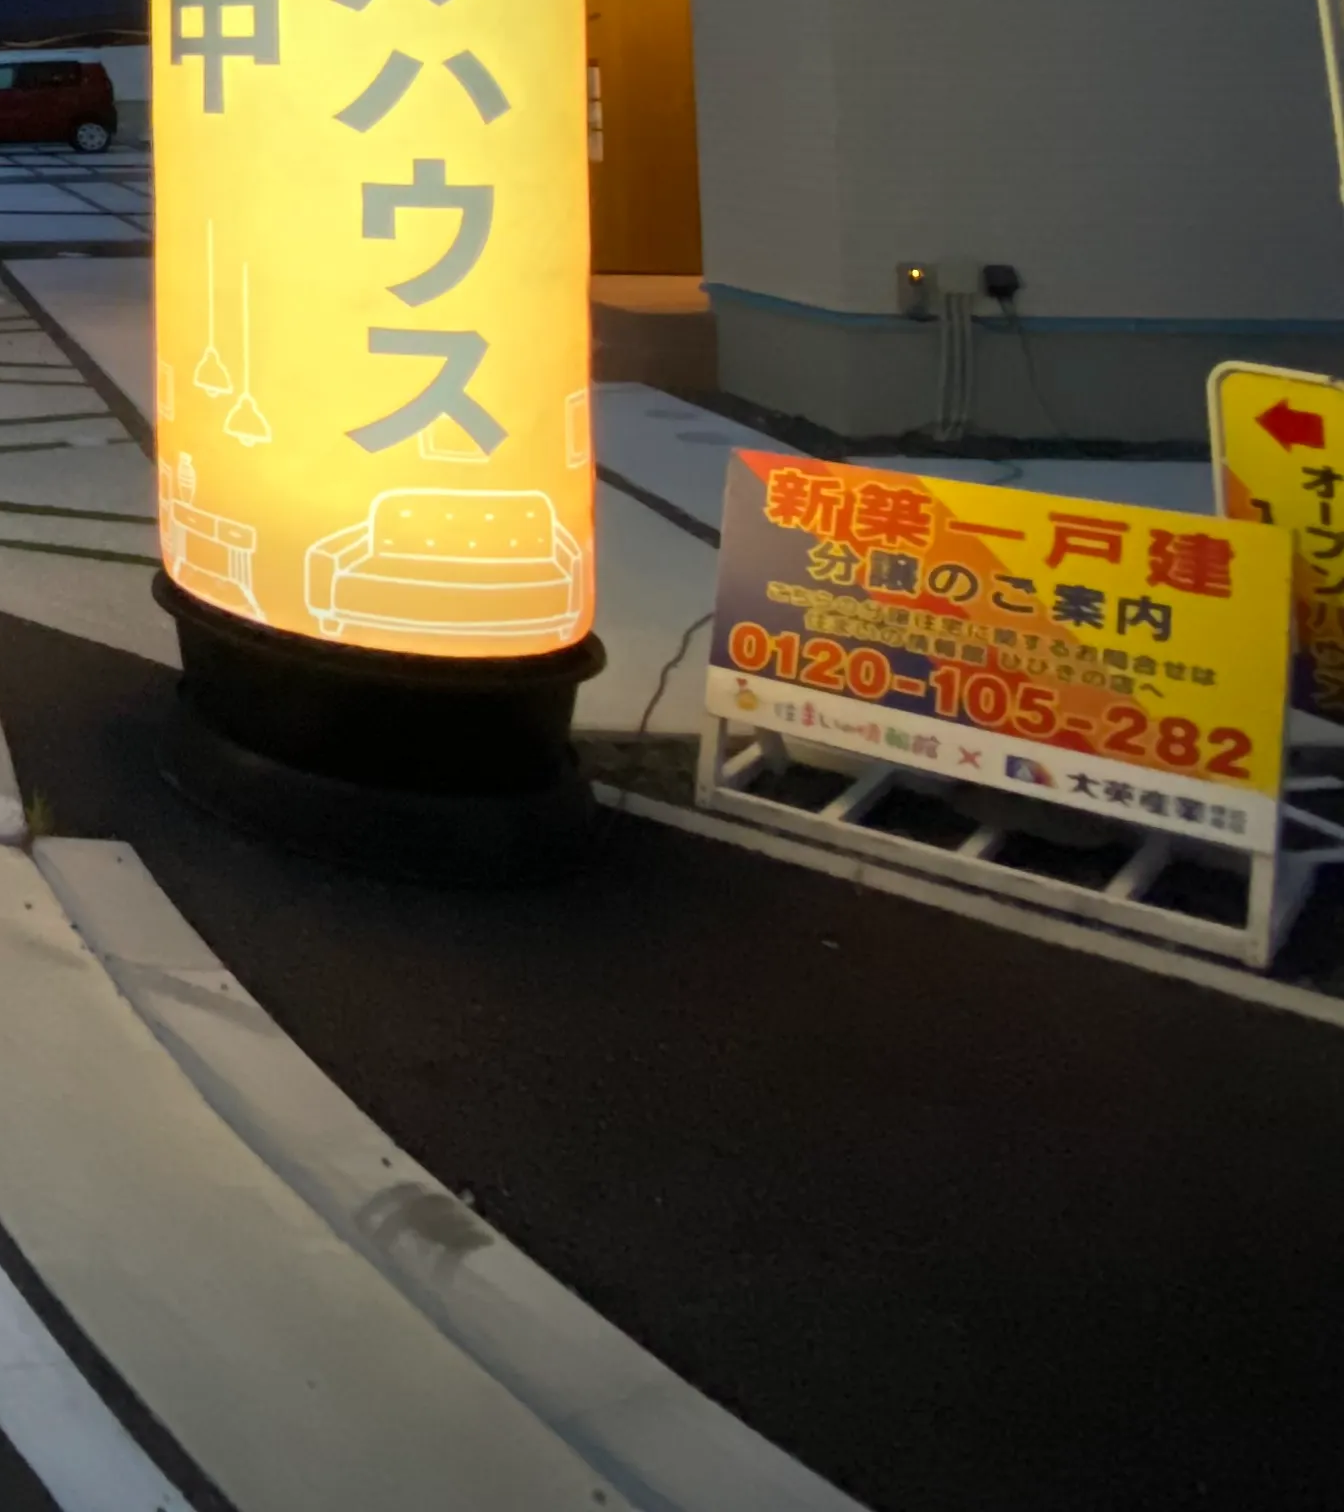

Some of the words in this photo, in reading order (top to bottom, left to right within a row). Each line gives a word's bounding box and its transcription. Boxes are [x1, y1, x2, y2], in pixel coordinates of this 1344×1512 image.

[765, 467, 1235, 599] 新築一戸建
[806, 540, 1173, 643] 分譲のご案内
[729, 620, 1253, 780] 0120-105-282
